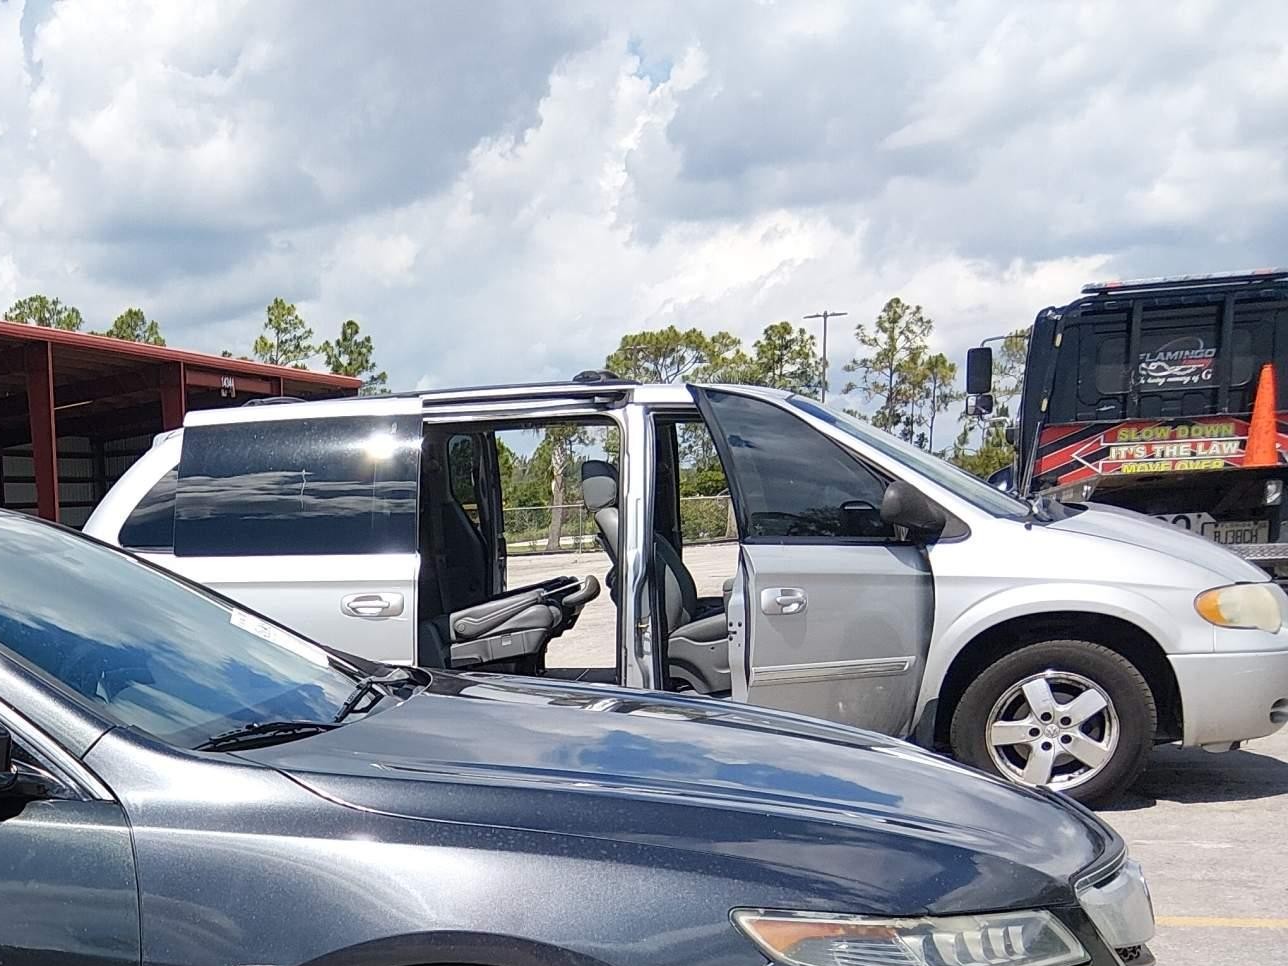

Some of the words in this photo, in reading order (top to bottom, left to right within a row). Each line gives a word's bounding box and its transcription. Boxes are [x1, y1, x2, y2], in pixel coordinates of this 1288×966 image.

[1139, 348, 1217, 362] FLAMINGO
[1117, 426, 1172, 441] SLOW
[1176, 423, 1235, 438] DOWN
[1109, 445, 1146, 460] IT'S
[1151, 443, 1191, 458] THE
[1196, 440, 1241, 455] LAW
[1121, 460, 1172, 473] MOVE
[1174, 459, 1225, 471] OVER
